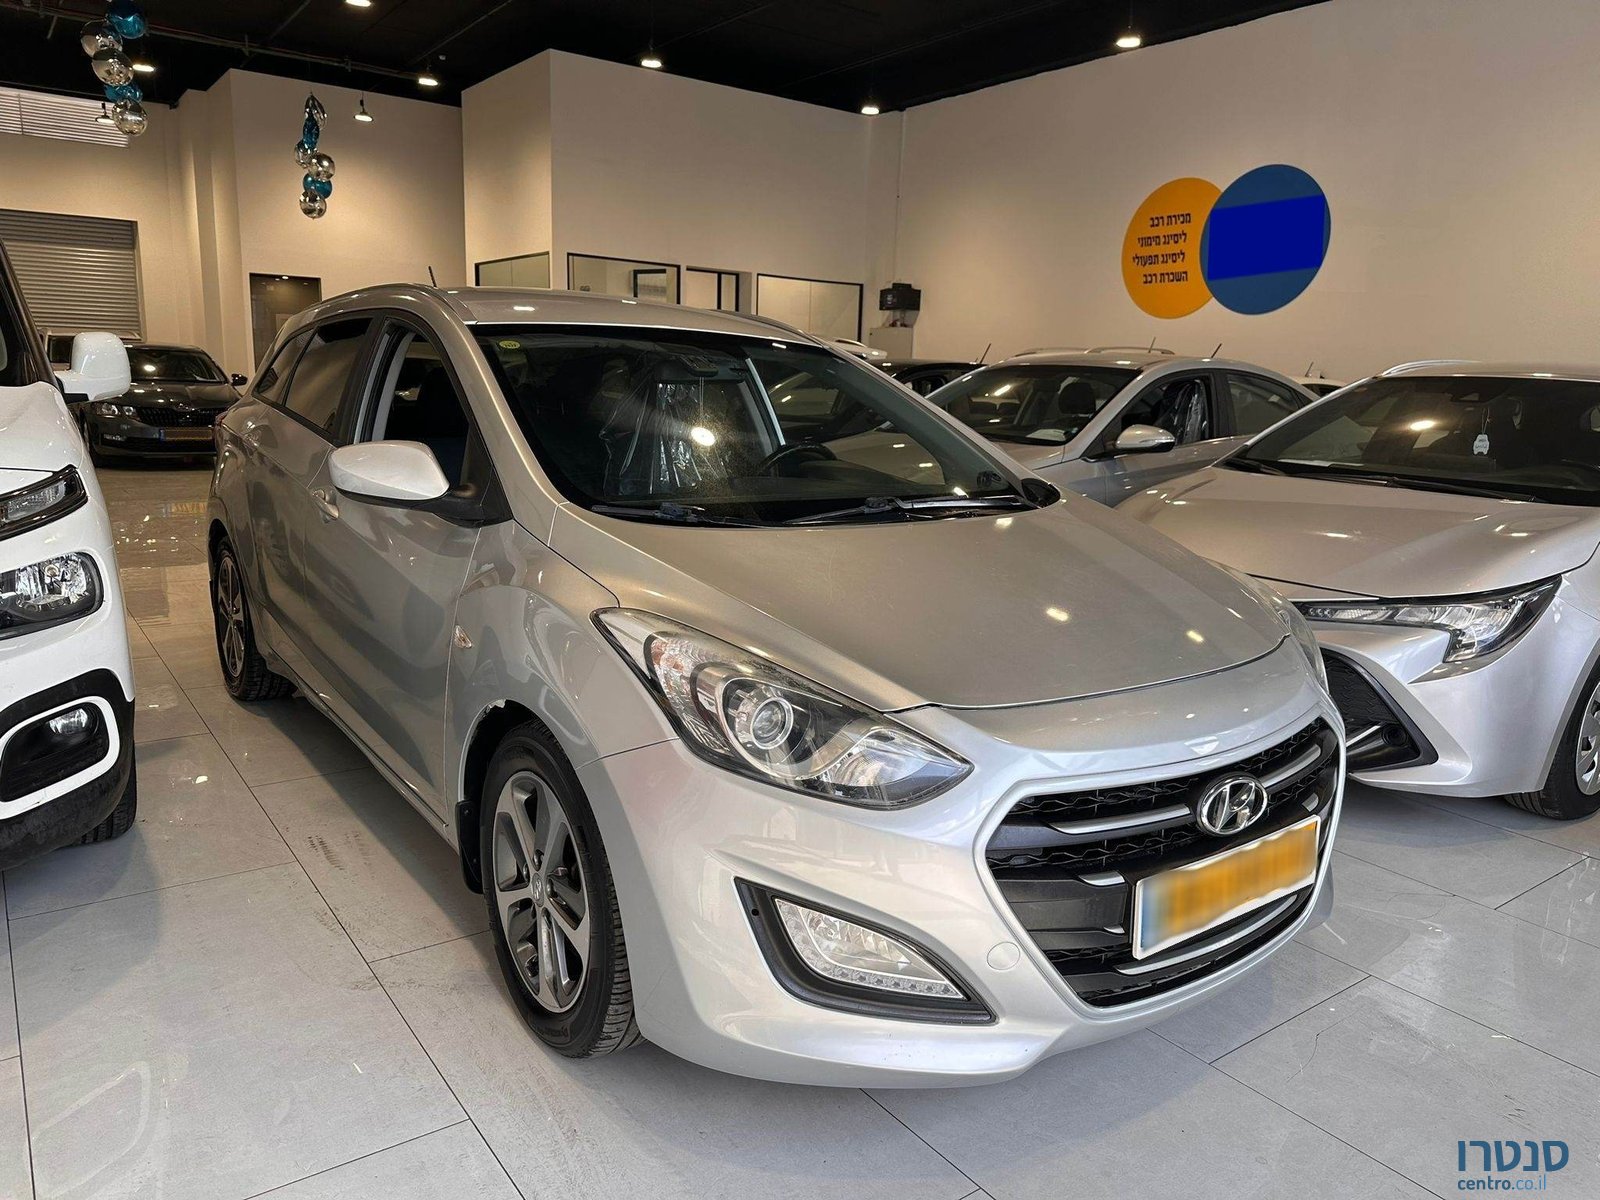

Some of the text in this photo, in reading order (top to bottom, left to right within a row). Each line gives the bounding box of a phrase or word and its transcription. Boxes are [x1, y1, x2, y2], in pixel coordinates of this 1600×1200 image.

[1150, 213, 1191, 228] מכירת רכב
[1138, 230, 1187, 247] ליסינג מימוני
[1133, 249, 1185, 267] ליסינג תפעולי
[1143, 271, 1188, 284] השכרת רכב
